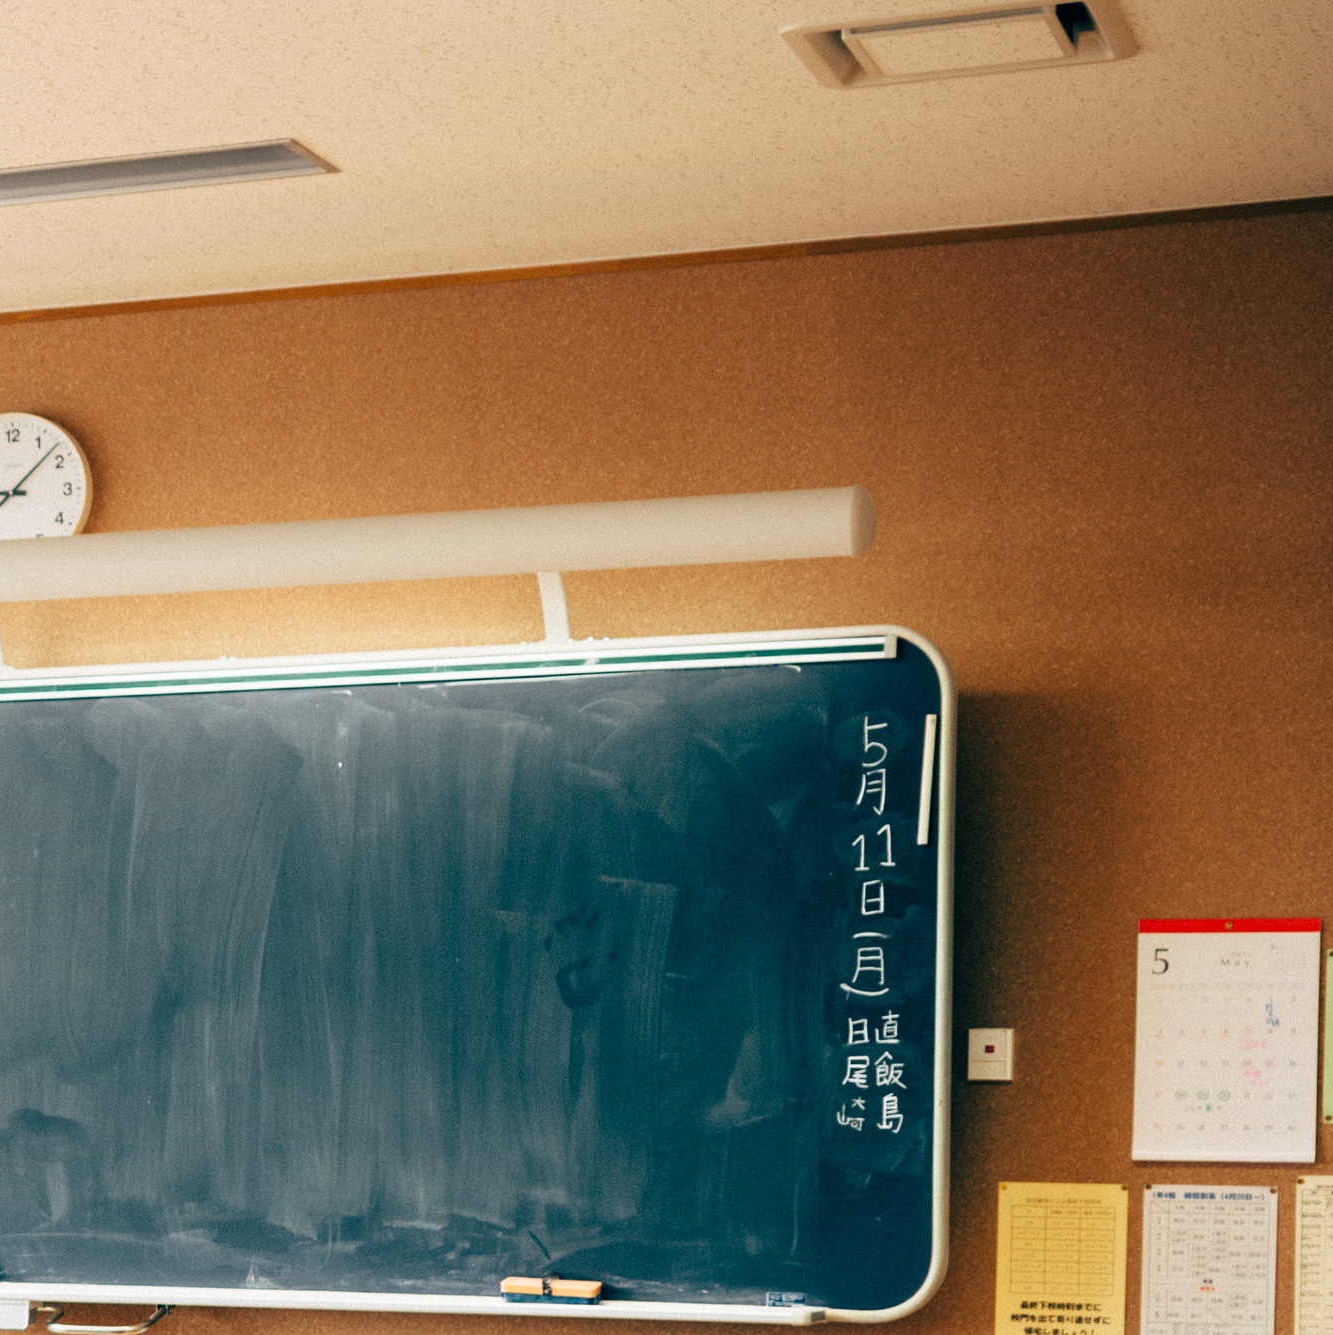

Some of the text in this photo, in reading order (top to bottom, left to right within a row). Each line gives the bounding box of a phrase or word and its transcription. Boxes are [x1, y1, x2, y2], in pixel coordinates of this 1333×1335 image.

[6, 428, 20, 442] 12
[35, 437, 41, 449] 1
[55, 455, 64, 469] 2
[63, 482, 73, 496] 3
[54, 512, 65, 525] 4
[1152, 948, 1170, 975] 5
[1220, 958, 1251, 968] May
